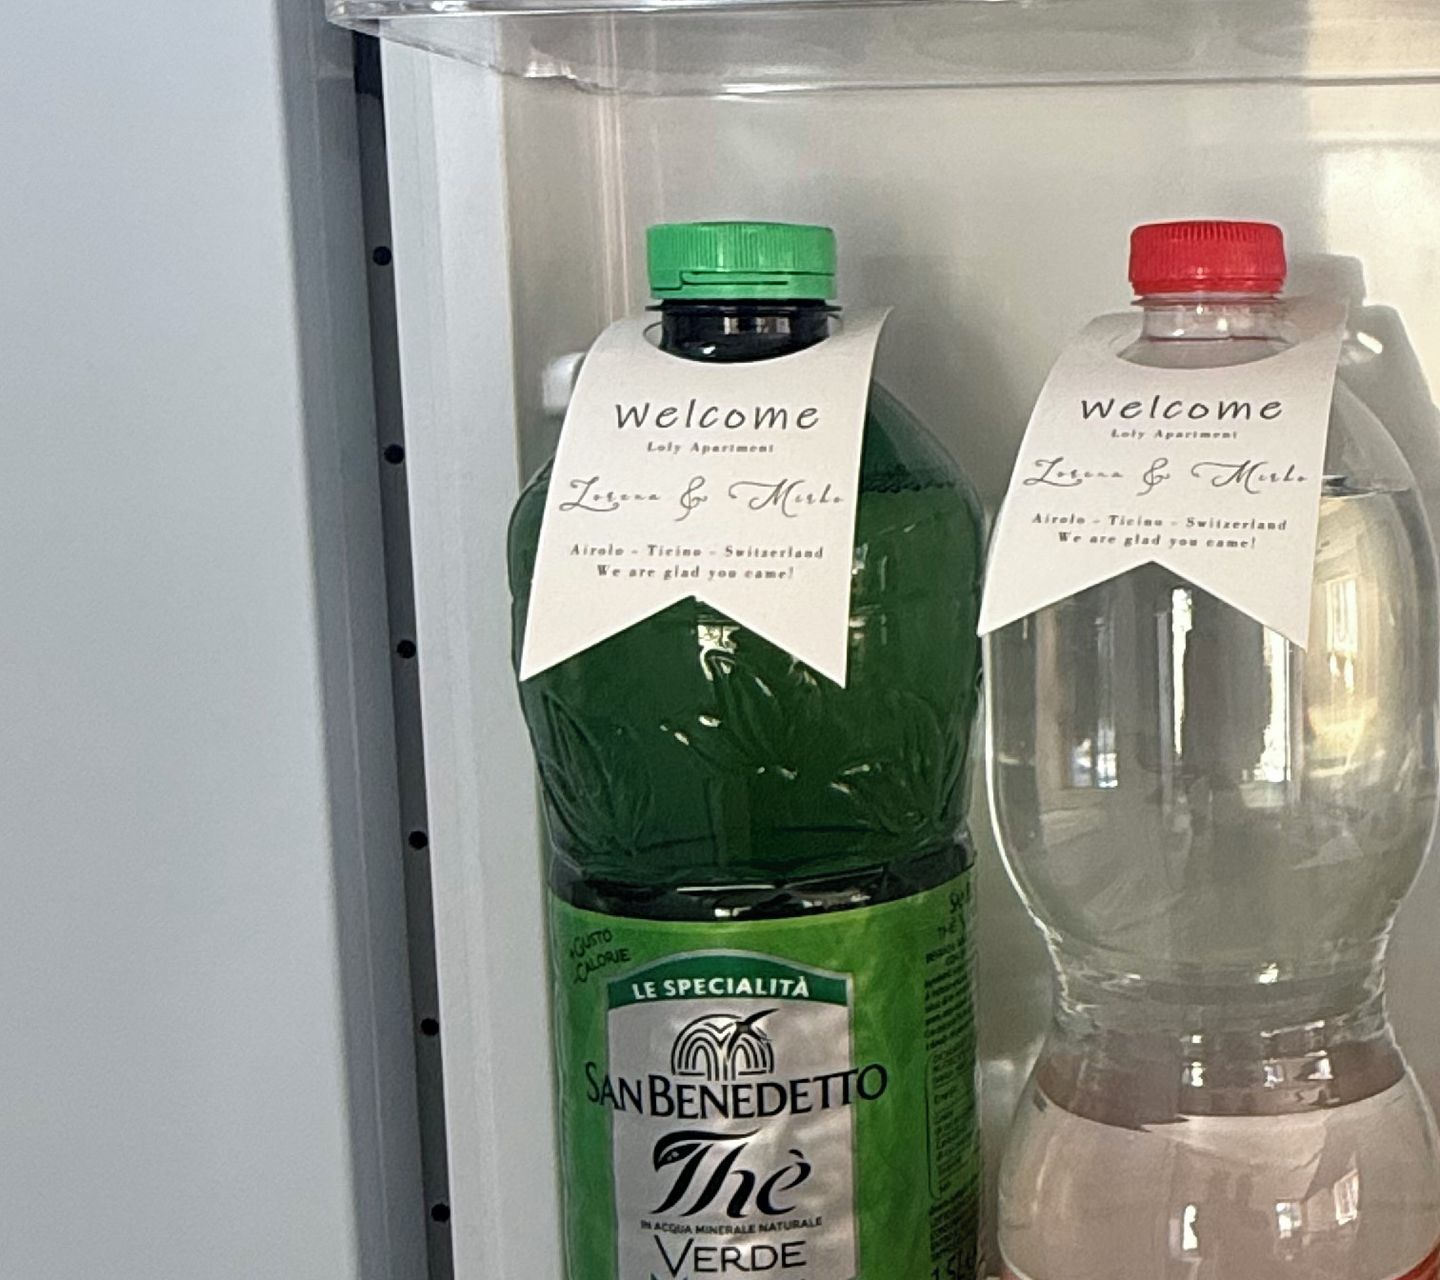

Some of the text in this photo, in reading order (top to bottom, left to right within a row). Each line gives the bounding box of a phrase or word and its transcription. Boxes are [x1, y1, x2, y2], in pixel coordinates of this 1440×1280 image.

[646, 441, 774, 456] Loly Apartment
[674, 475, 709, 522] &
[1032, 513, 1288, 531] Airolo Ticino Switzerland
[1058, 532, 1257, 549] We are glad you came!
[570, 544, 824, 559] Airolo Ticino Switzerland
[597, 565, 794, 581] We are glad you came!
[632, 976, 810, 1000] LE SPECIALITÀ
[650, 1128, 812, 1218] Thè
[654, 1222, 692, 1234] ACQUA
[695, 1224, 757, 1234] MINERALE
[759, 1217, 823, 1232] NATURALE
[653, 1234, 808, 1278] VERDE
